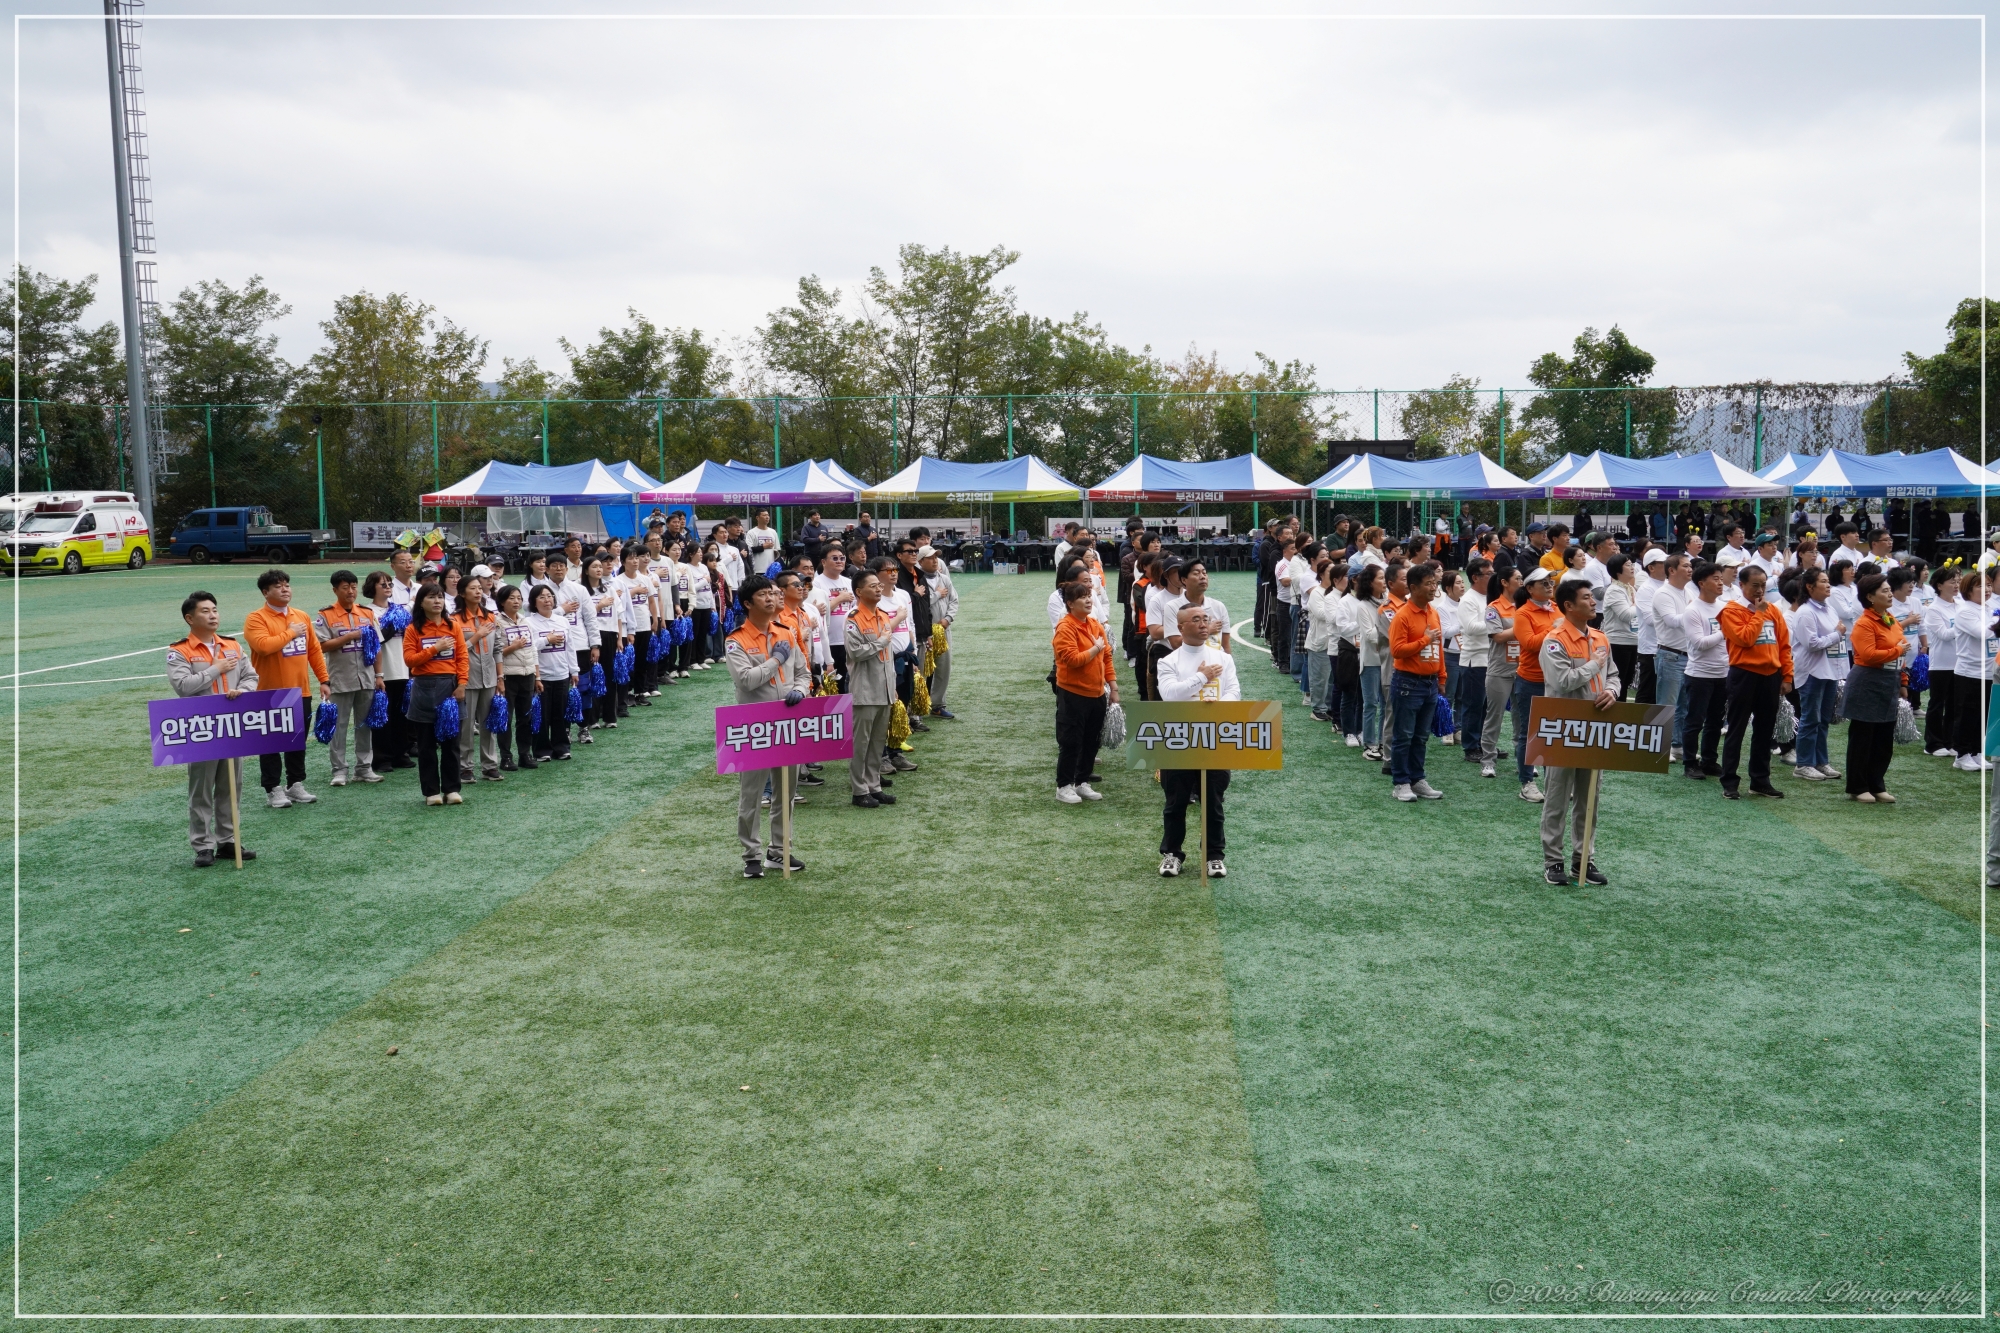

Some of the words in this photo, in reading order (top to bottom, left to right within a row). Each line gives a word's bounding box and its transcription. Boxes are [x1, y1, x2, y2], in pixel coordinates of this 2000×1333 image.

[945, 492, 993, 502] 수정지역대
[1175, 491, 1224, 502] 부전지역대
[1886, 486, 1937, 497] 범일지역대
[503, 496, 550, 506] 안창지역대
[722, 494, 770, 504] 부암지역대
[125, 516, 136, 526] 119
[160, 707, 295, 746] 안창지역대
[725, 713, 844, 752] 부암지역대
[1136, 721, 1272, 750] 수정지역대
[1537, 717, 1664, 753] 부전지역대
